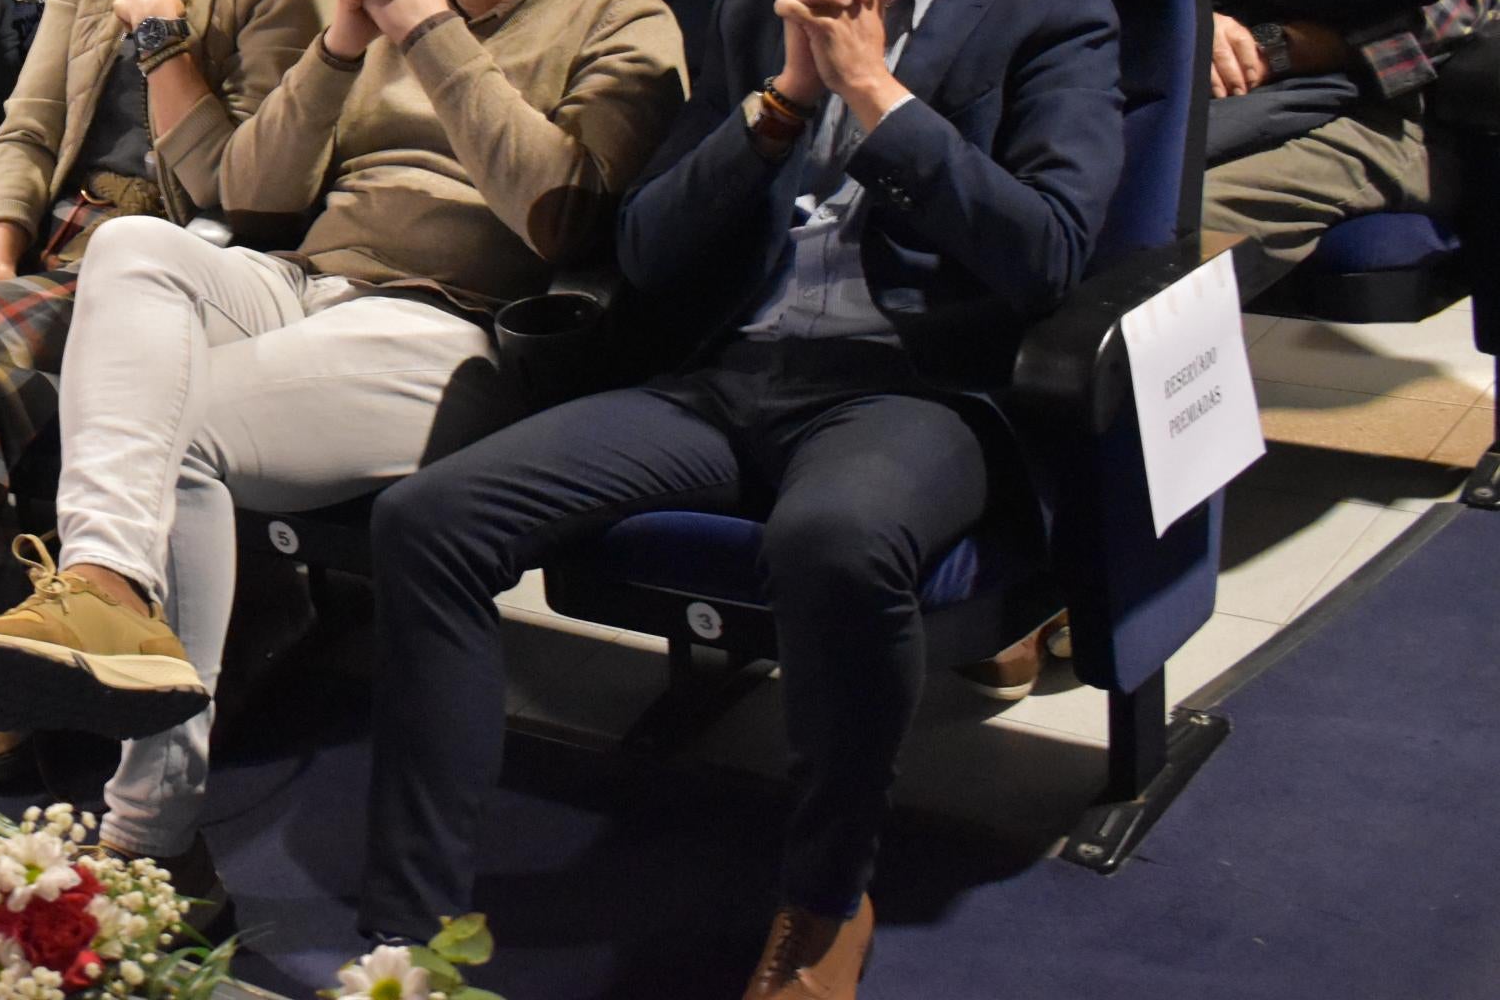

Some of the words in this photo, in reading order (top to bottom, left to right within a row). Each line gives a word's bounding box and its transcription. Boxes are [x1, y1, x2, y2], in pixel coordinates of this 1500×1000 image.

[1164, 346, 1218, 399] RESERVADO
[1169, 385, 1222, 438] PREMIADAS
[277, 530, 291, 547] 5
[697, 613, 713, 631] 3
